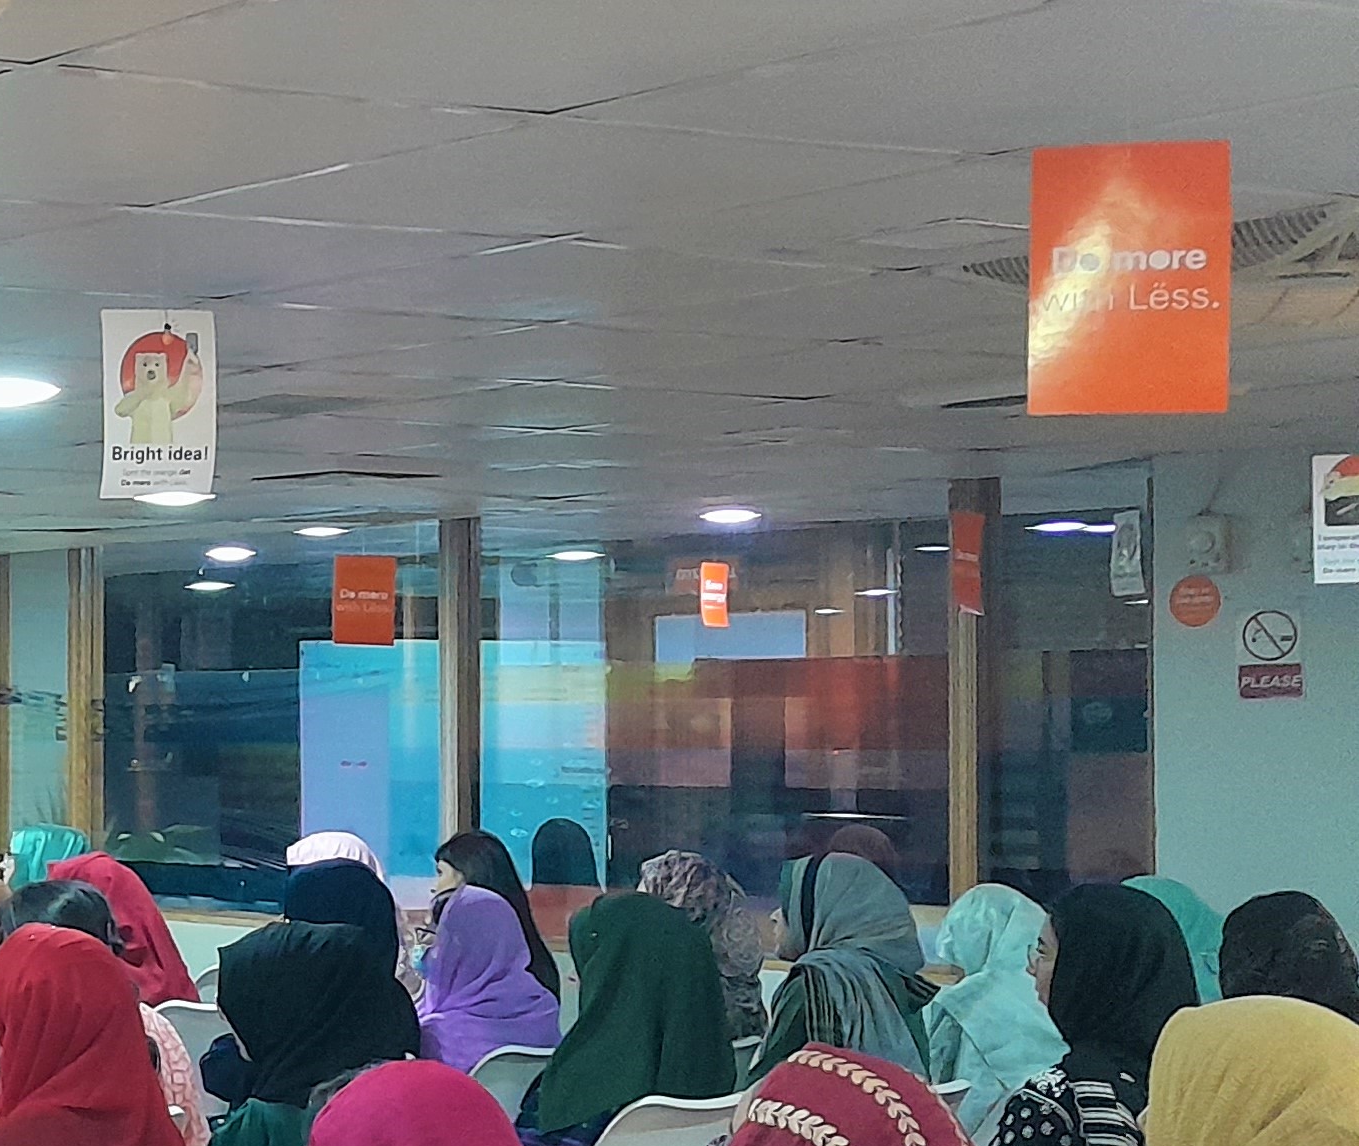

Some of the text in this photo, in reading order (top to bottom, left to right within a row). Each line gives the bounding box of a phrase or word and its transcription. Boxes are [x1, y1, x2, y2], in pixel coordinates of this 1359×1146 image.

[1052, 247, 1207, 274] Do more
[112, 446, 209, 464] Bright idea!
[1240, 675, 1303, 689] PLEASE
